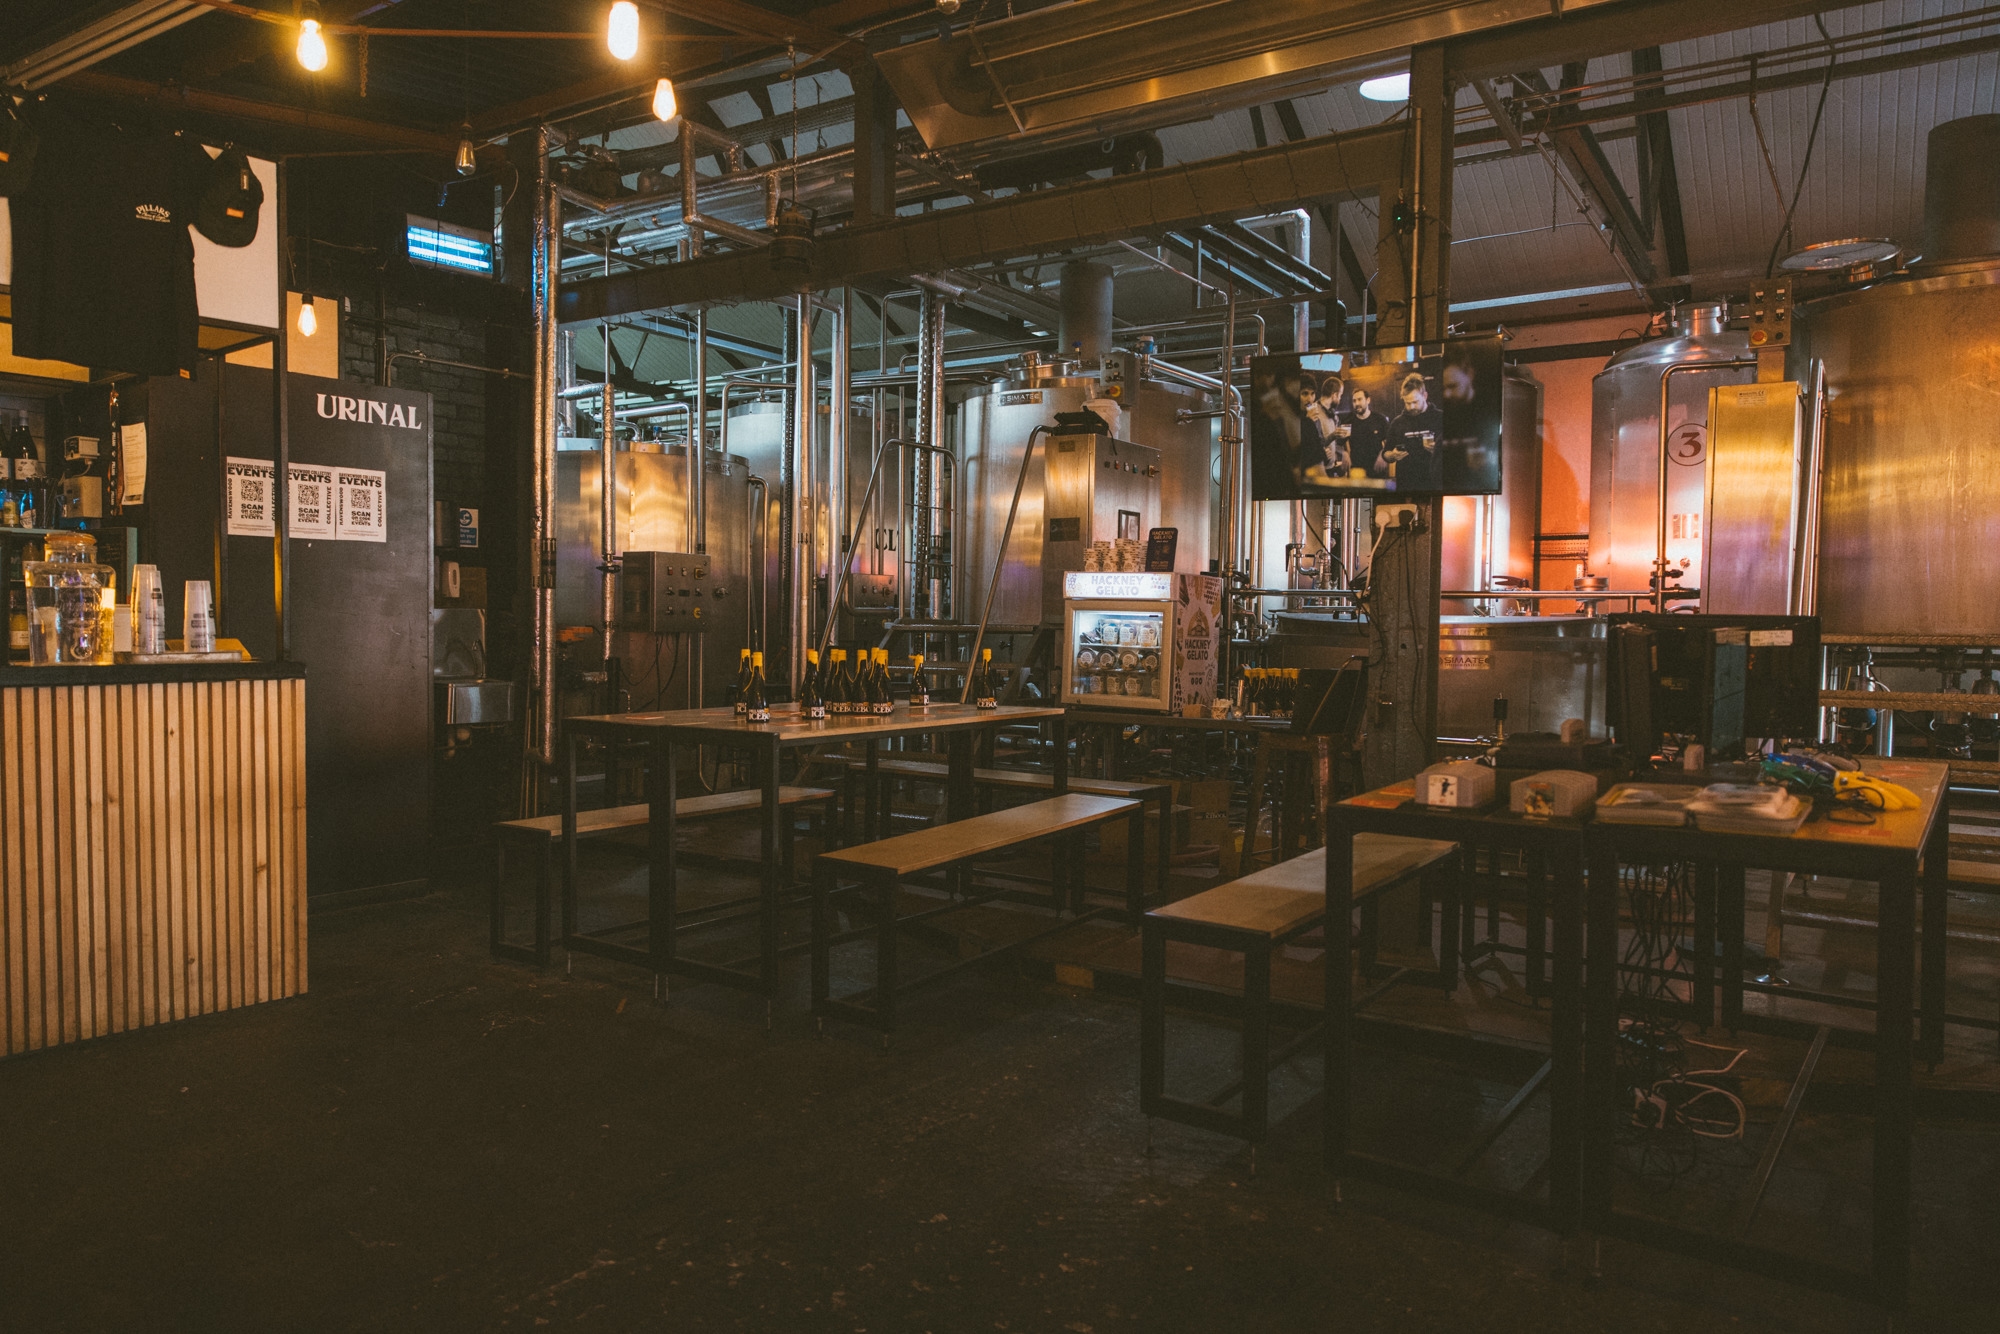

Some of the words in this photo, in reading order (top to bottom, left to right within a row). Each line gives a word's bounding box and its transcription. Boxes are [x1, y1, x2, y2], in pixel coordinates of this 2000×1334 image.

[136, 204, 170, 218] PILLARS
[316, 393, 422, 430] URINAL
[1678, 431, 1702, 458] 3
[228, 467, 275, 479] EVENTS
[339, 476, 382, 488] EVENTS
[241, 503, 264, 511] SCAN
[1091, 576, 1145, 585] HACKNEY
[1096, 586, 1140, 596] GELATO
[1185, 639, 1211, 650] HACKNEY
[1186, 650, 1209, 660] GELATO
